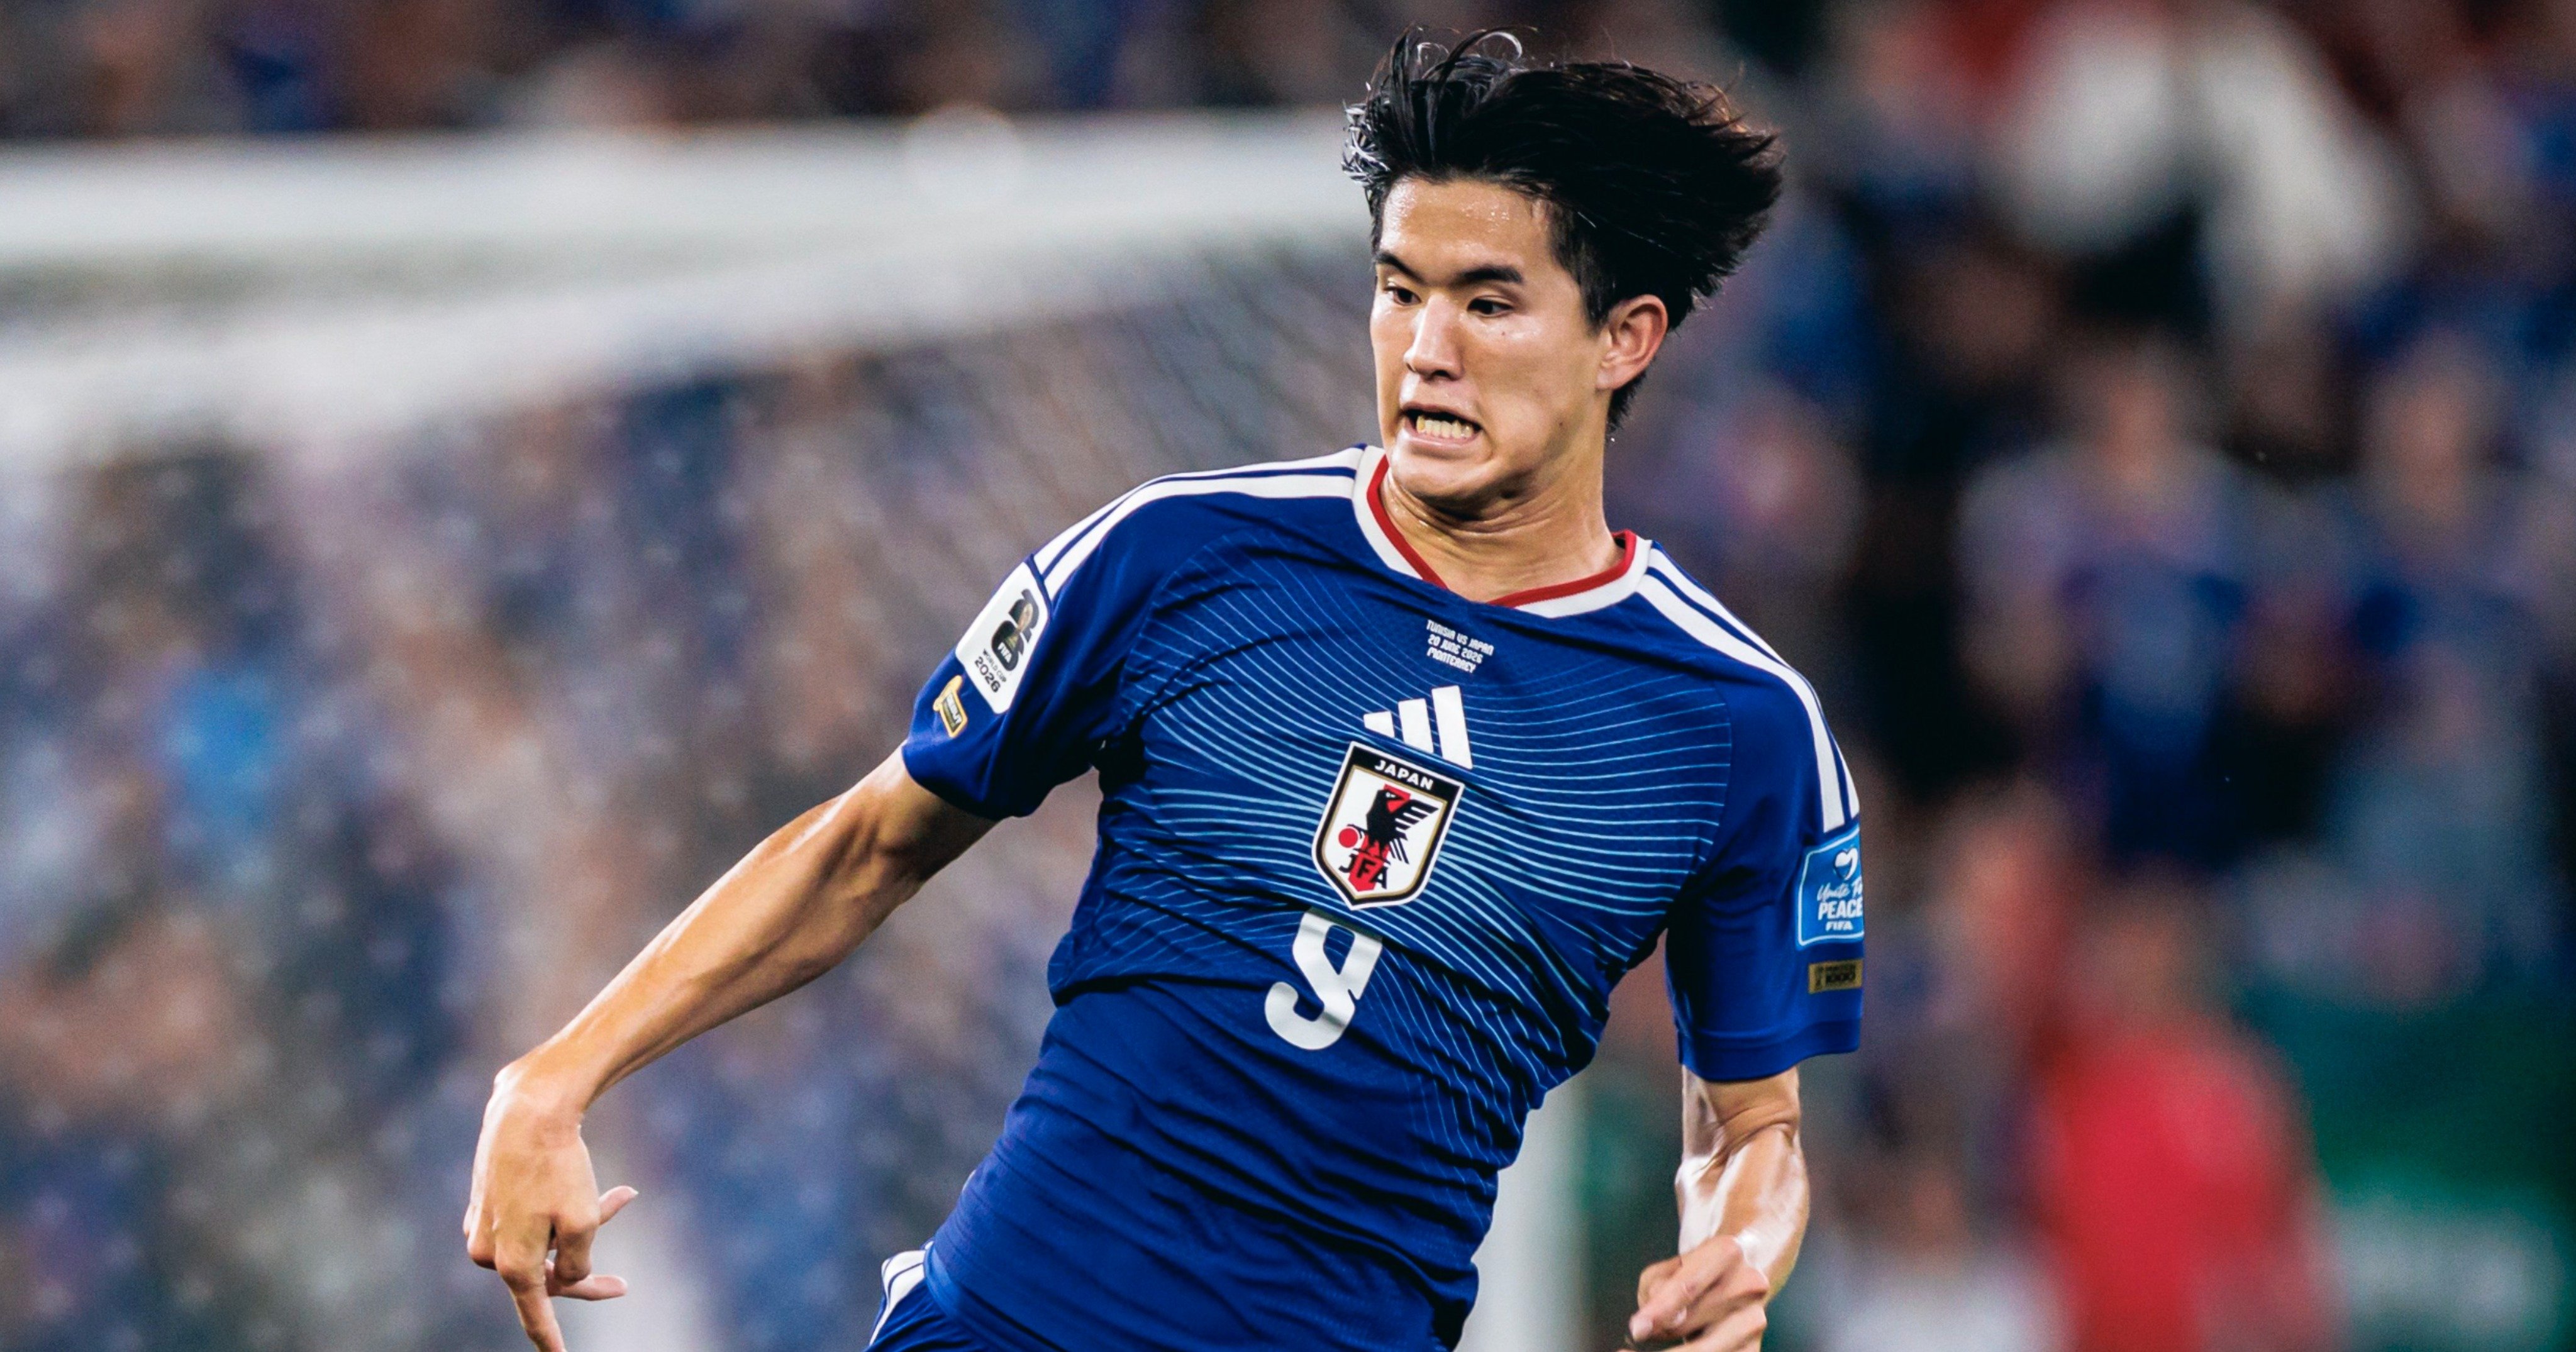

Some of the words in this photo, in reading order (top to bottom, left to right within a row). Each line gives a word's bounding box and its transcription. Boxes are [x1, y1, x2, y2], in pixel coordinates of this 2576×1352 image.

[1428, 634, 1441, 646] 20
[1468, 638, 1494, 656] JAPAN
[975, 656, 1001, 693] 2026
[1374, 760, 1434, 790] JAPAN
[1338, 853, 1389, 889] JFA
[1818, 895, 1863, 921] PEACE
[1826, 920, 1853, 931] FIFA
